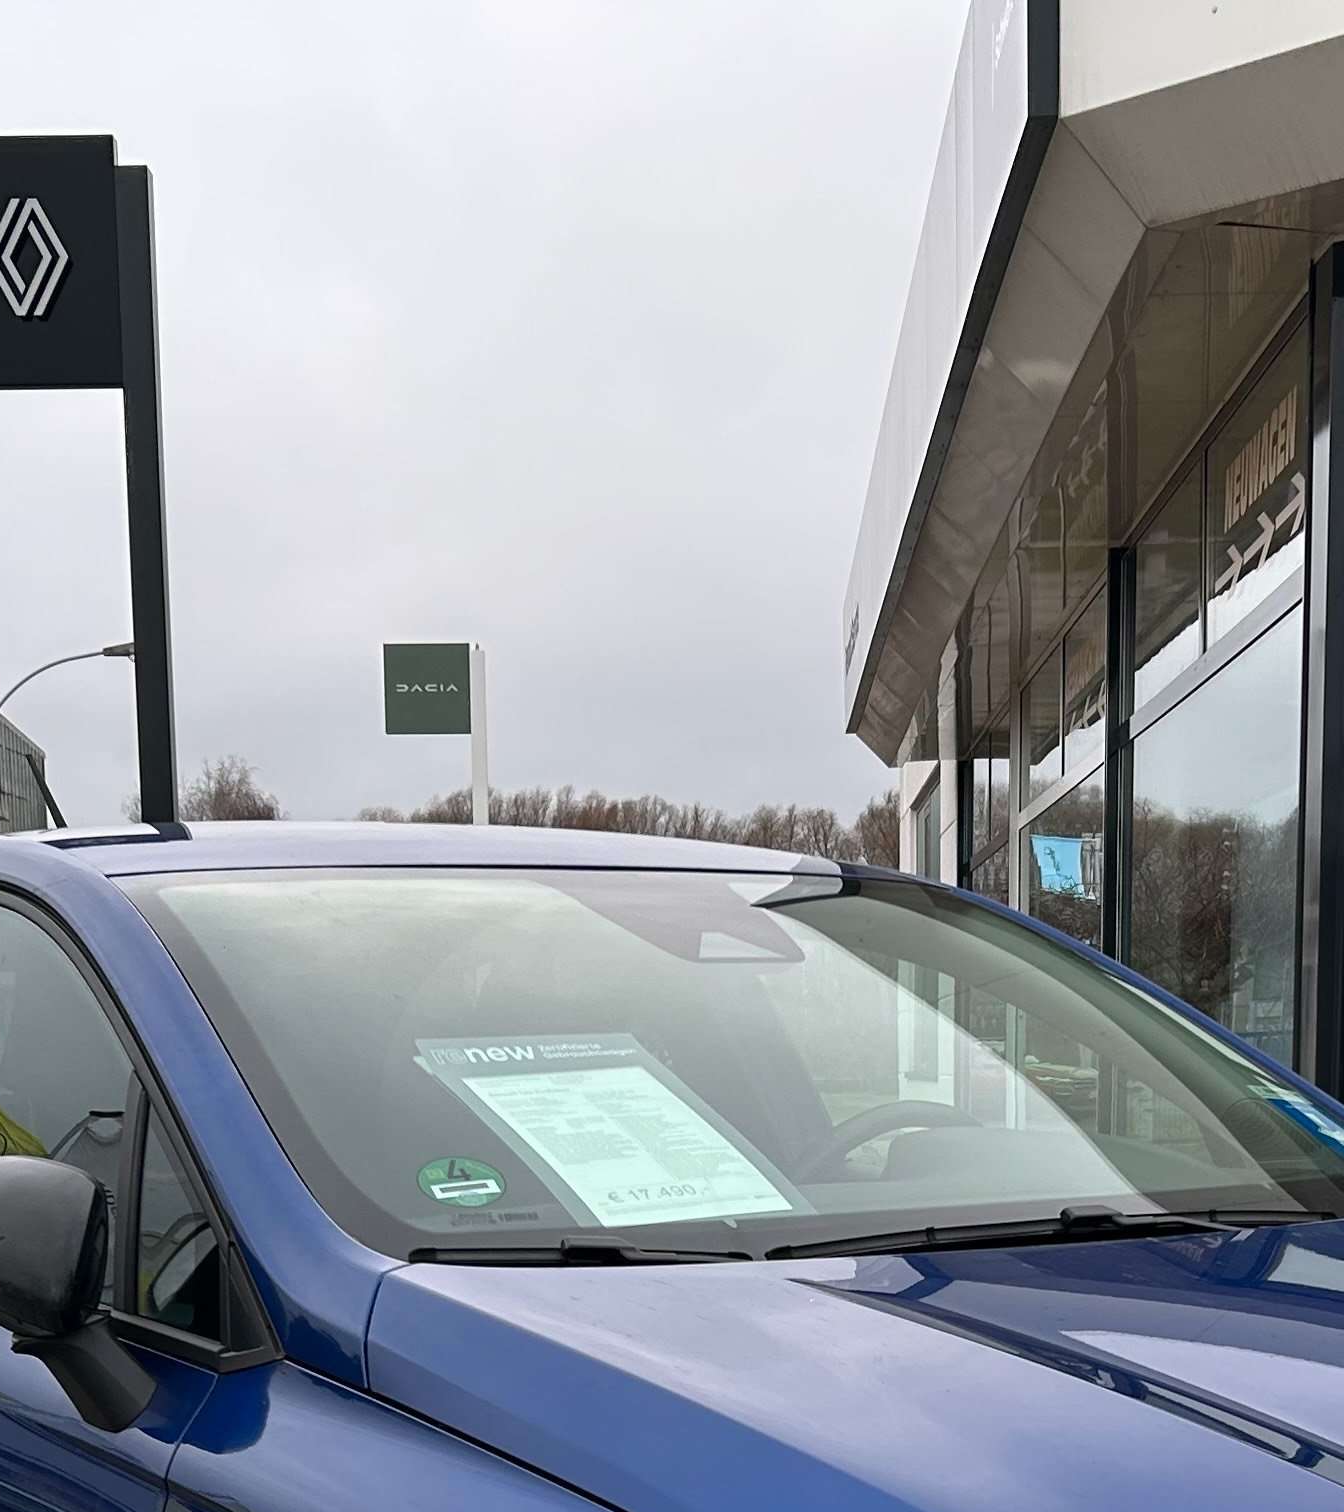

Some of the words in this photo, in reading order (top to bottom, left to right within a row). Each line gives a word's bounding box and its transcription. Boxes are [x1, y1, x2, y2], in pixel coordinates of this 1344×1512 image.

[1224, 384, 1298, 535] NEUWAGEN
[395, 683, 459, 693] DACIA
[448, 1160, 472, 1181] 4
